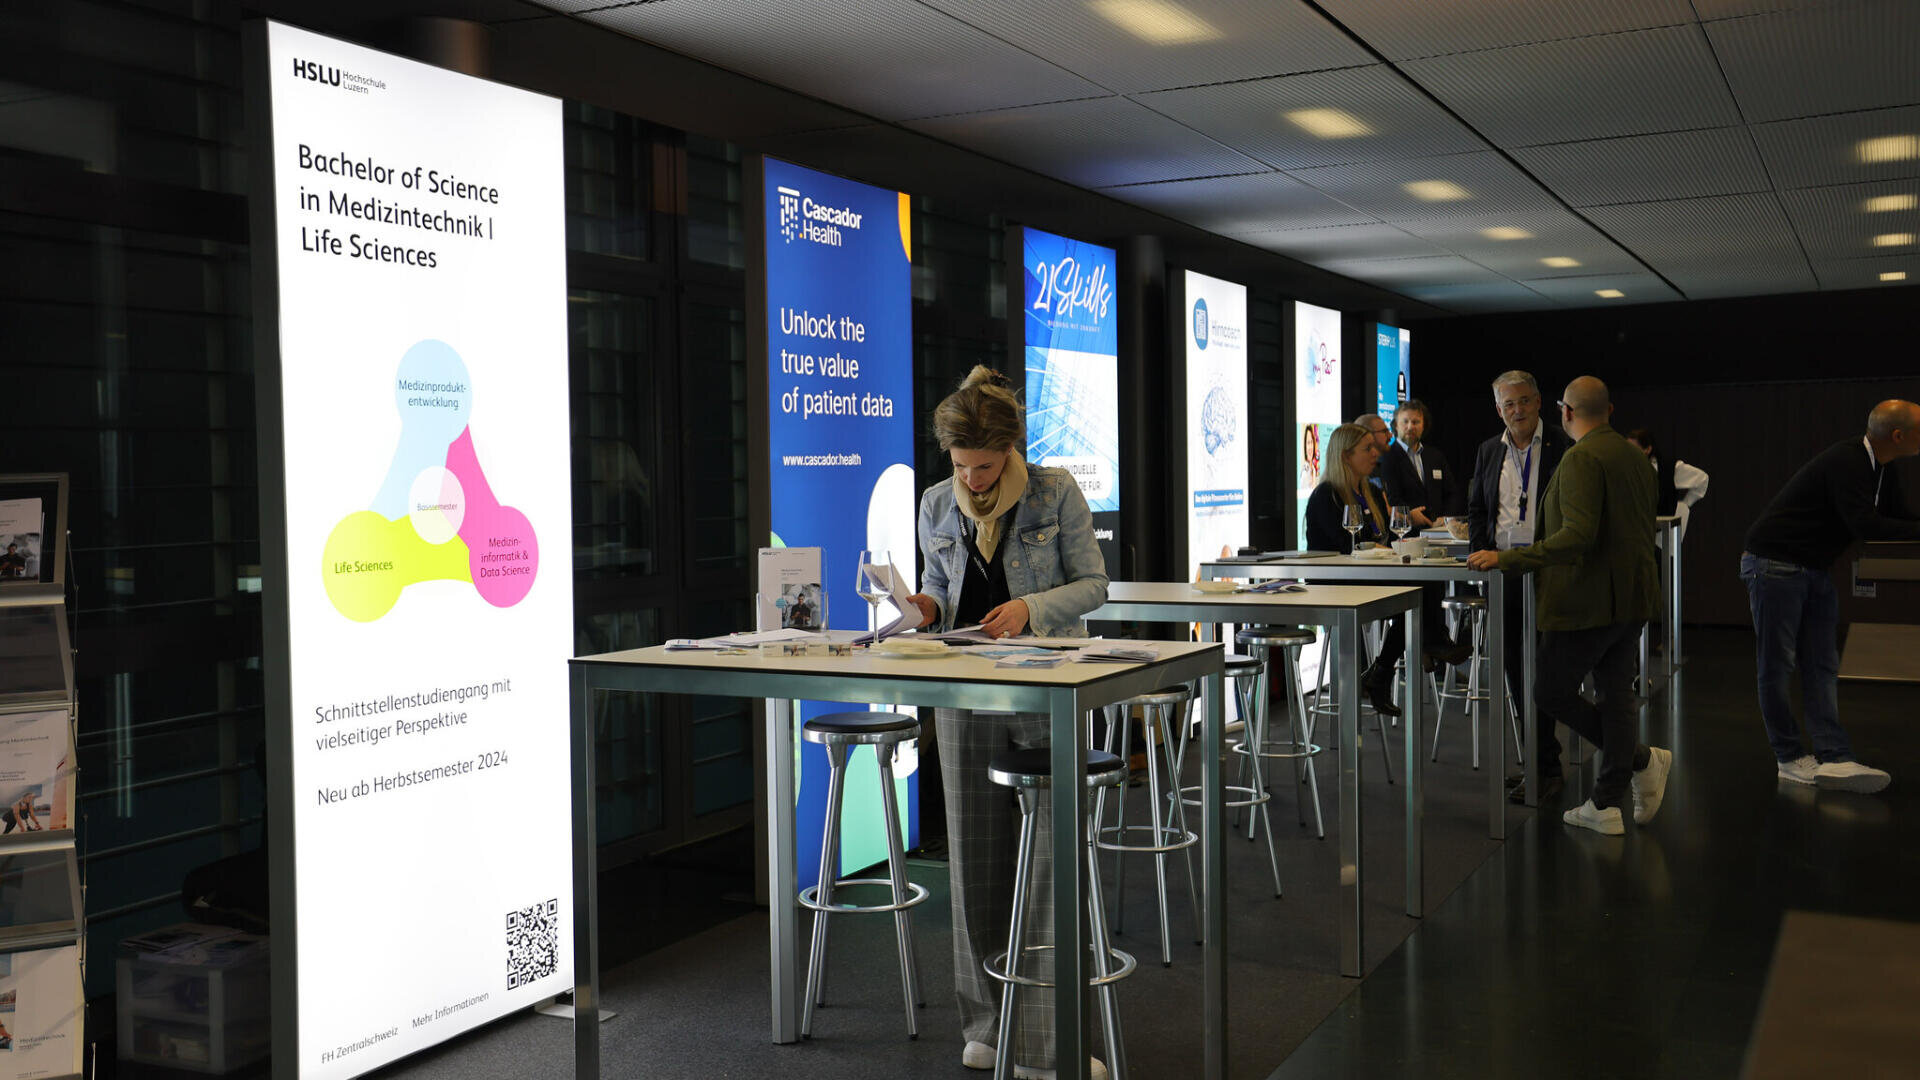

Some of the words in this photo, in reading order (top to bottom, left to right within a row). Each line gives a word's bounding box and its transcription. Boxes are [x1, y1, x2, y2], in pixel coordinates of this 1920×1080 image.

[293, 58, 340, 87] HSLU
[343, 70, 386, 89] Hochschule
[343, 81, 369, 94] Luzern
[299, 144, 395, 185] Bachelor
[401, 167, 423, 190] of
[428, 170, 499, 204] Science
[300, 187, 320, 211] in
[328, 190, 484, 239] Medizintechnik
[803, 198, 862, 229] Cascador
[302, 227, 342, 256] Life
[350, 233, 437, 268] Sciences
[804, 219, 842, 246] Health
[780, 307, 837, 339] Unlock
[840, 316, 865, 343] the
[781, 349, 815, 375] true
[818, 353, 859, 379] value
[399, 379, 466, 395] Medizinprodukt-
[408, 396, 459, 411] entwicklung
[782, 386, 800, 413] of
[803, 389, 858, 420] patient
[861, 392, 893, 418] data
[783, 453, 862, 466] www.cascador.health
[480, 551, 520, 563] informatik
[522, 550, 529, 561] &
[488, 537, 521, 548] Medizin-
[335, 562, 352, 574] Life
[354, 559, 394, 573] Sciences
[480, 567, 500, 578] Data
[502, 564, 530, 577] Science
[315, 683, 489, 724] Schnittstellenstudiengang
[491, 678, 512, 694] mit
[315, 722, 392, 751] vielseitiger
[395, 709, 468, 735] Perspektive
[317, 788, 347, 805] Neu
[351, 779, 370, 798] ab
[373, 757, 475, 793] Herbstsemester
[477, 750, 509, 770] 2024
[412, 1014, 433, 1029] Mehr
[435, 991, 490, 1022] Informationen
[321, 1049, 335, 1064] FH
[336, 1026, 399, 1059] Zentralschweiz
